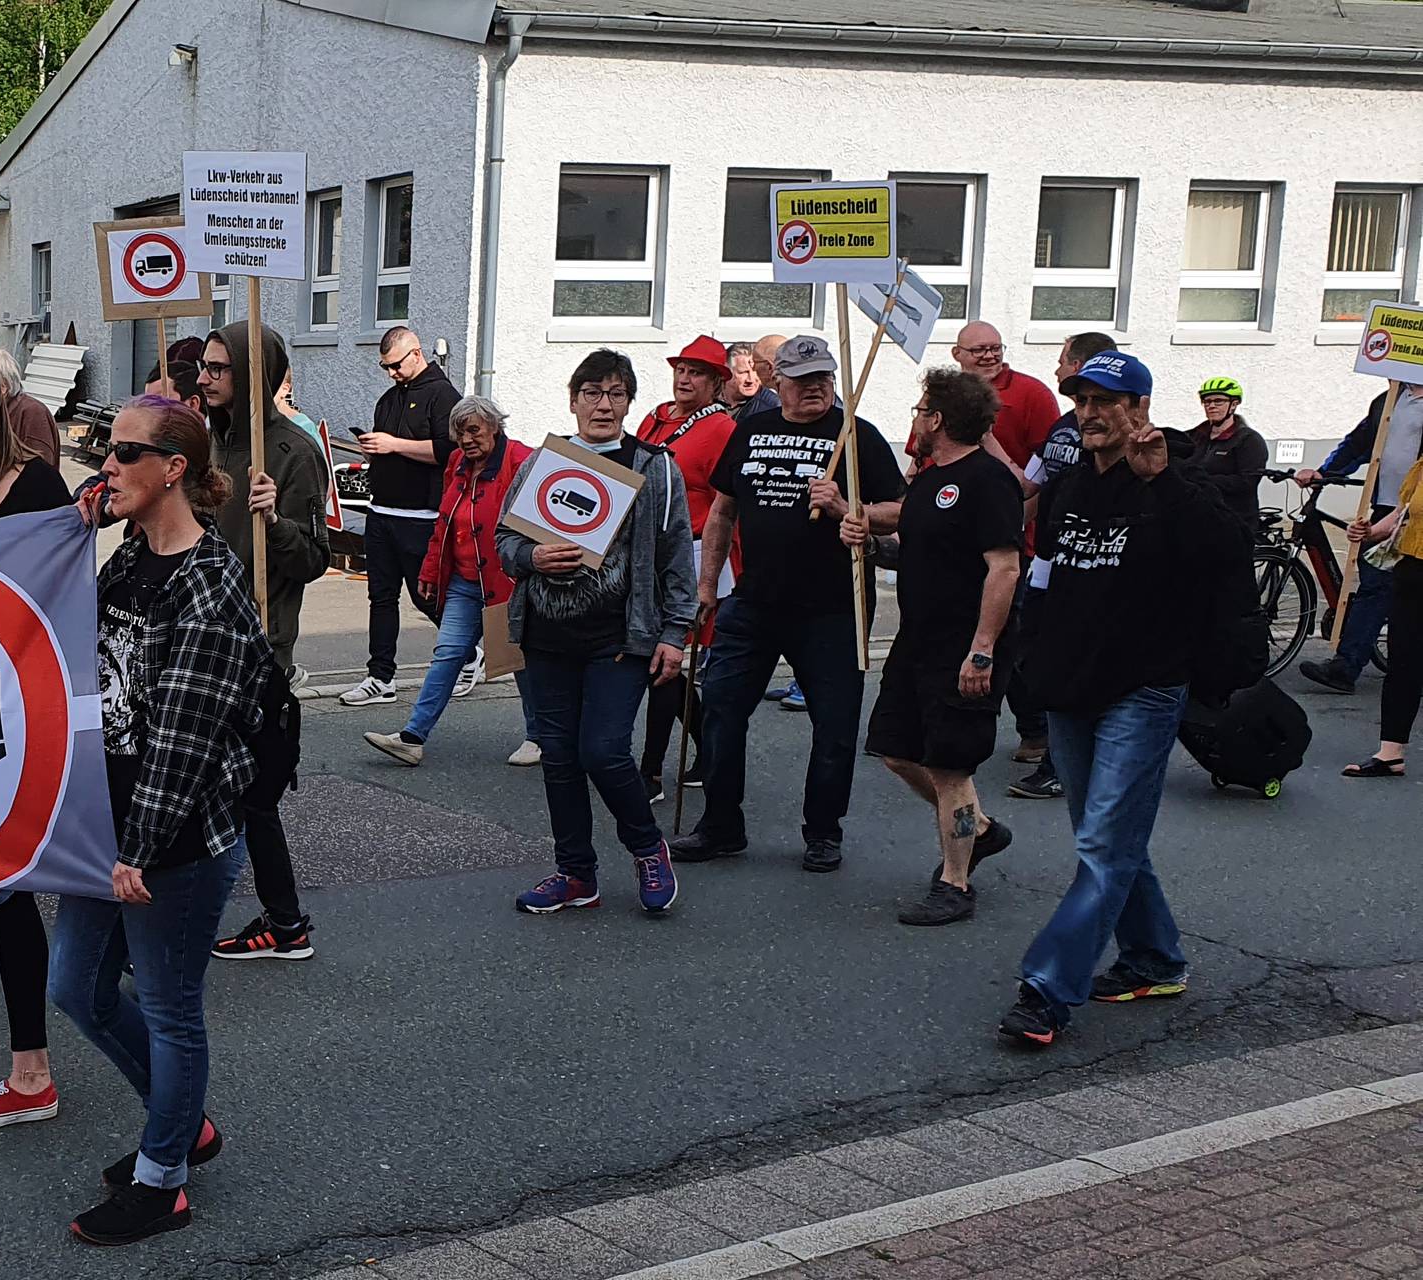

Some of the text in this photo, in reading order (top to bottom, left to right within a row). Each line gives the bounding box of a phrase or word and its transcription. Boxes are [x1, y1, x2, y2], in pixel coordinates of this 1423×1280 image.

[207, 169, 283, 185] Lkw-Verkehr aus
[190, 187, 299, 205] Lüdenscheid verbannen!
[791, 198, 877, 216] Lüdenscheid
[207, 213, 284, 231] Menschen an der
[204, 231, 287, 250] Umleitungsstrecke
[818, 233, 875, 247] freie Zone
[224, 251, 267, 267] schützen!
[1391, 342, 1410, 354] freie
[748, 434, 837, 452] GENERVTER
[748, 448, 813, 461] ANWOHNER
[751, 478, 764, 487] Am
[770, 499, 795, 508] Grund
